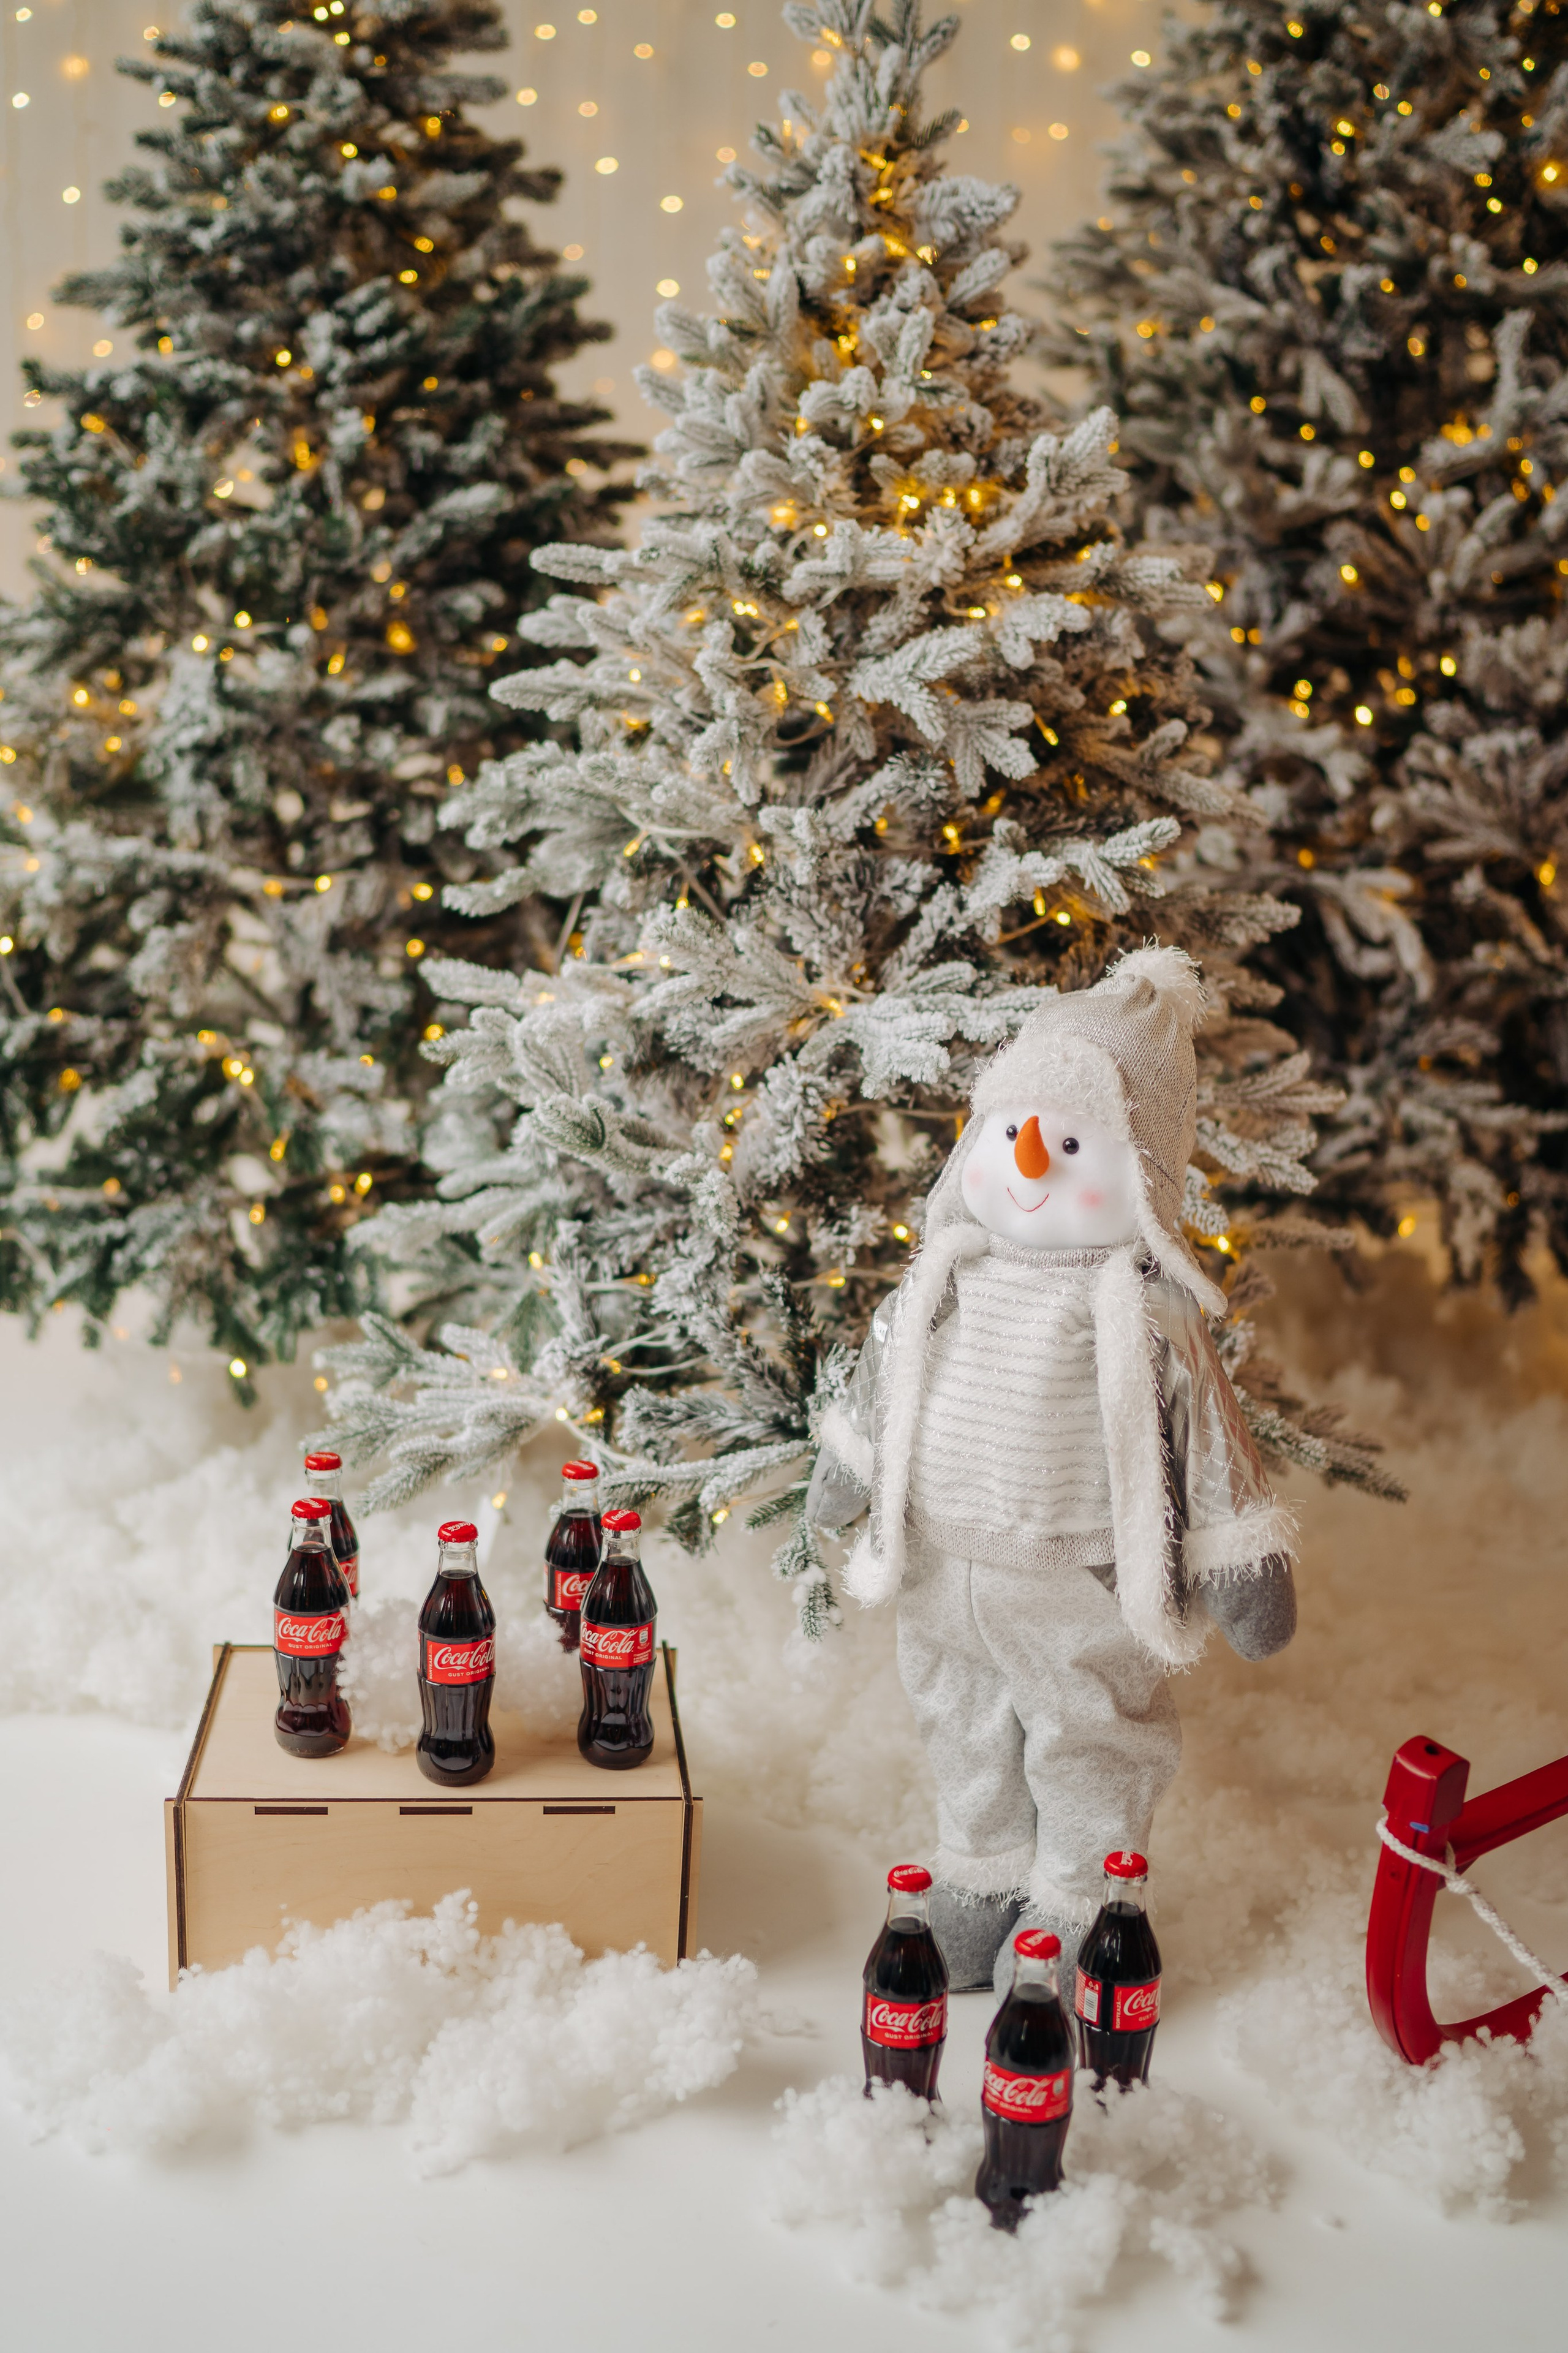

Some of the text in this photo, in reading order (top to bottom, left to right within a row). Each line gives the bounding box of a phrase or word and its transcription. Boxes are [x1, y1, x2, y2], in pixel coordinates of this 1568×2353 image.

[279, 1614, 343, 1642] Coca-Cola
[581, 1621, 638, 1653] Coca-Cola
[466, 1665, 489, 1676] ORIGINAL
[872, 1998, 943, 2033] Coca-Cola
[984, 2061, 1052, 2106] Coca-Cola
